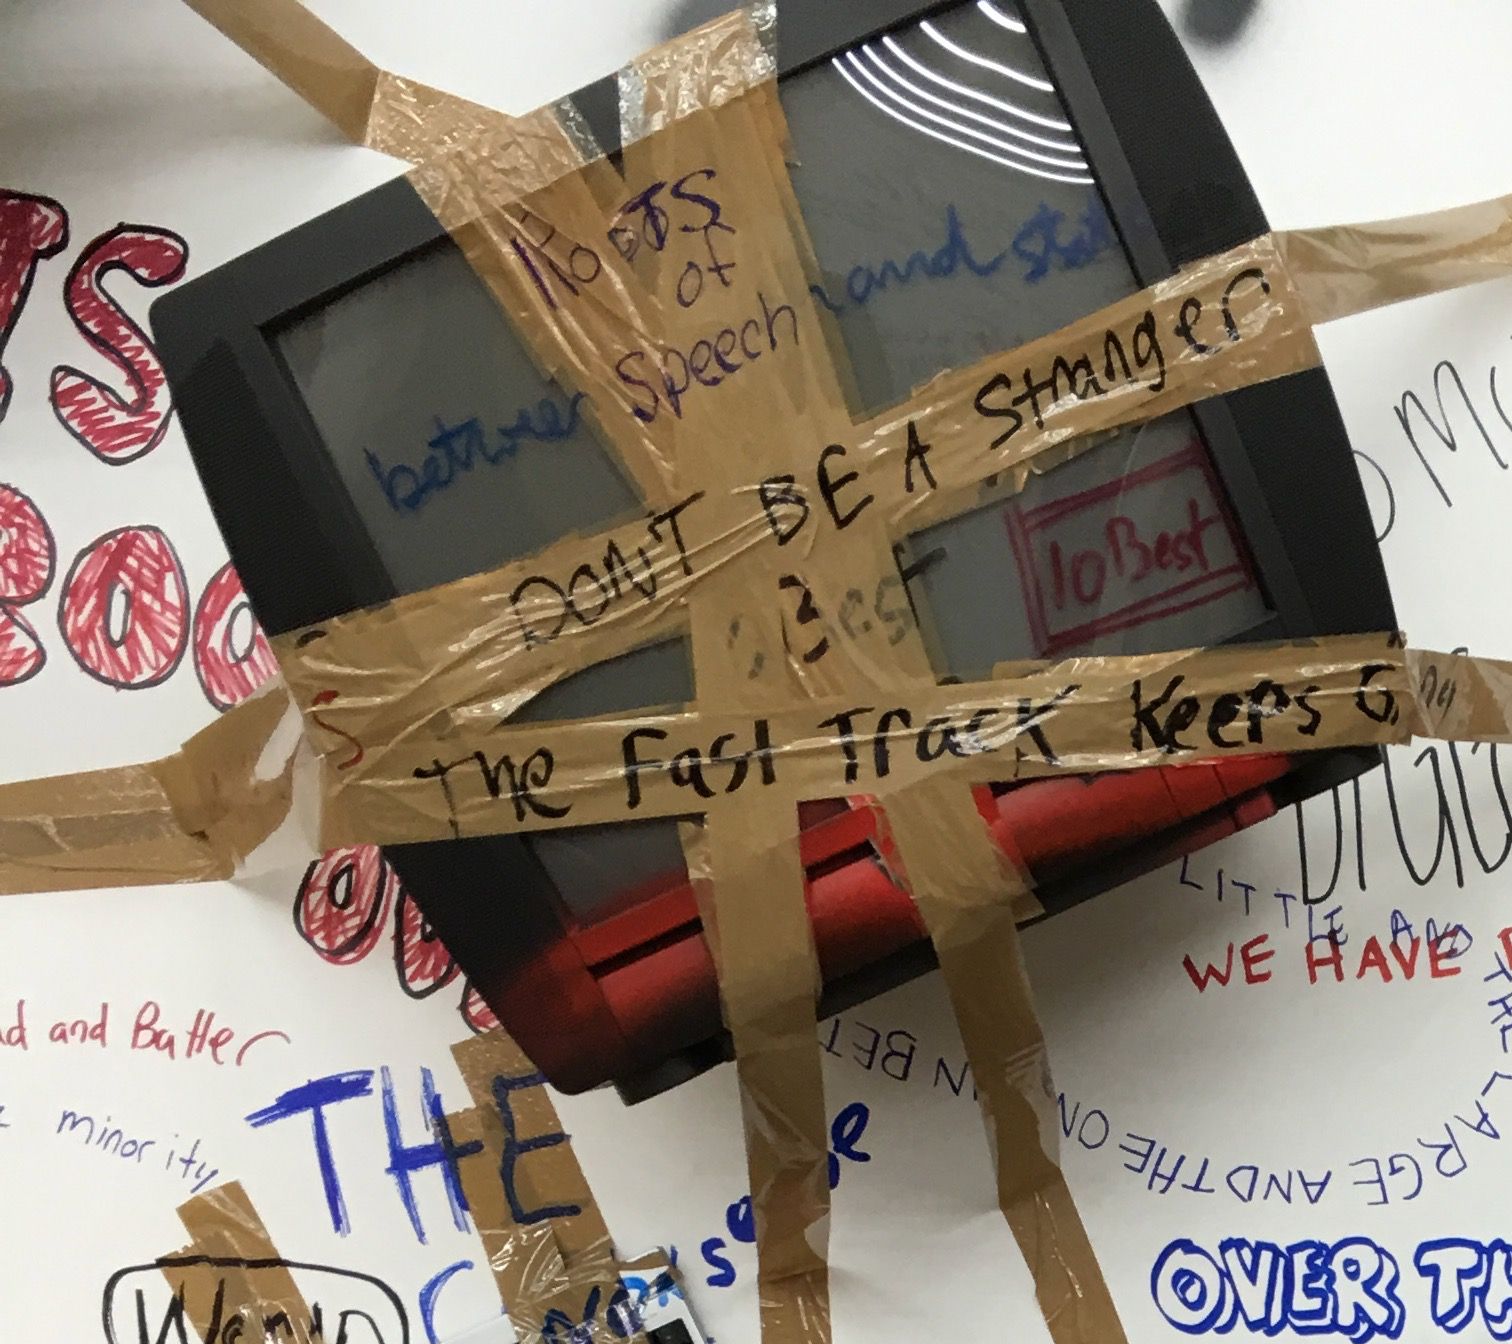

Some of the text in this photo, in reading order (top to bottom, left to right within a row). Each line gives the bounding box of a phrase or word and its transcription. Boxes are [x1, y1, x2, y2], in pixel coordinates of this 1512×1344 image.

[903, 420, 938, 492] A
[1181, 933, 1274, 993] WE
[1306, 930, 1464, 986] HAVE
